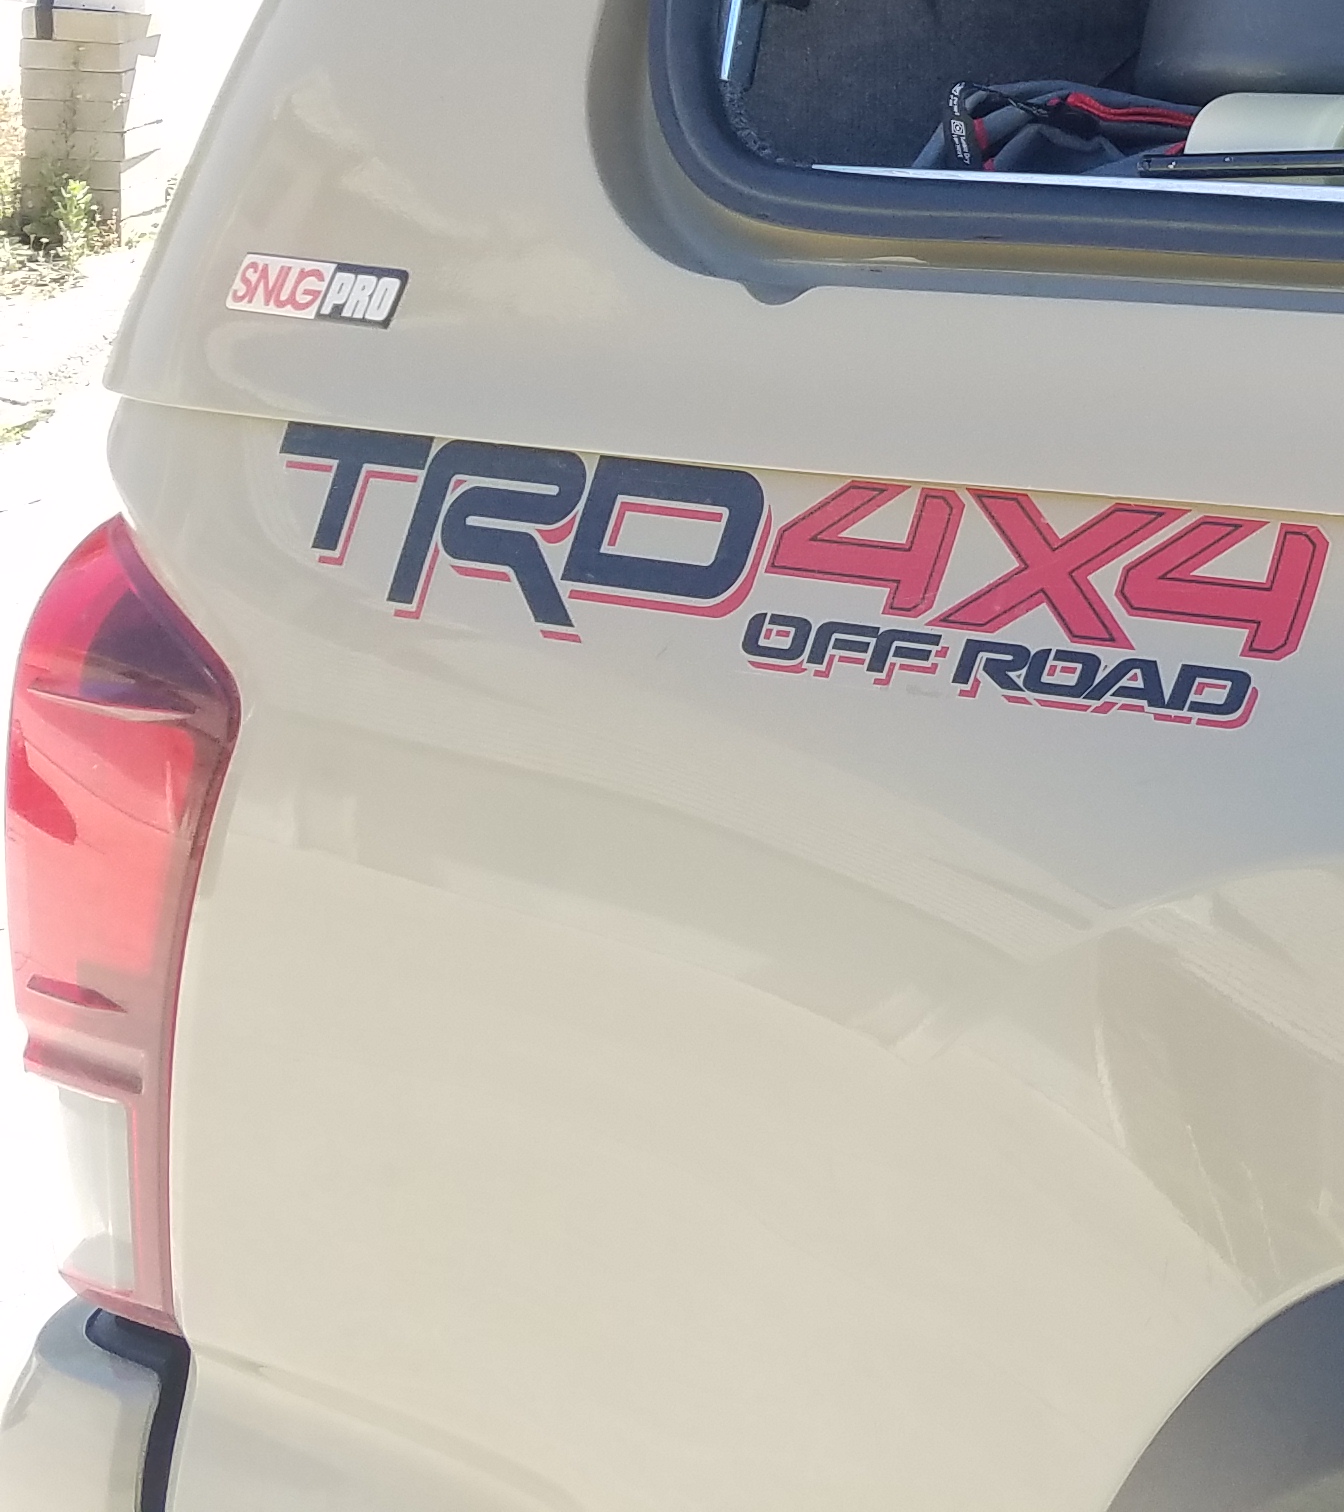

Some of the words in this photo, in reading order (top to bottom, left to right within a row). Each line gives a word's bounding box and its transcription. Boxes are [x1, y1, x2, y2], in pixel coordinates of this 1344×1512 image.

[231, 261, 325, 311] SNUG
[320, 272, 401, 321] PRO
[279, 420, 772, 644] TRD
[741, 611, 948, 686] OFF
[950, 637, 1259, 730] ROAD
